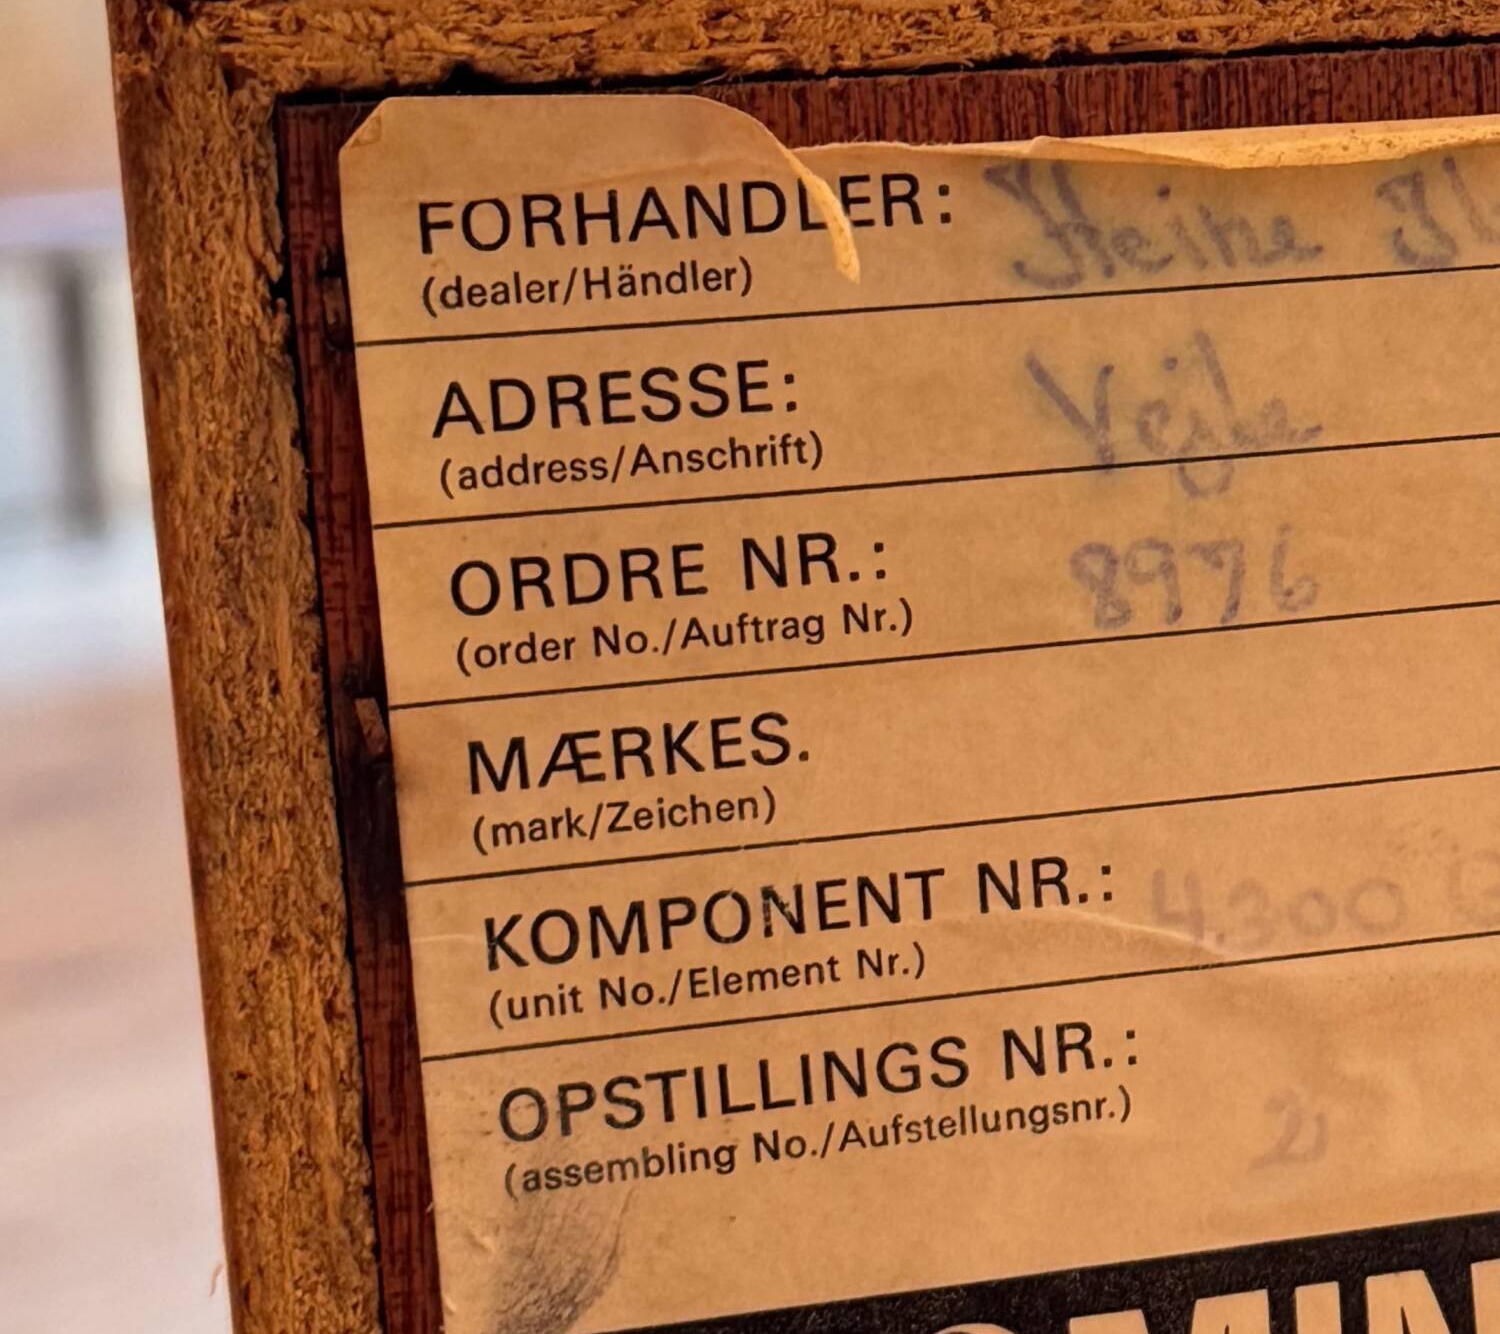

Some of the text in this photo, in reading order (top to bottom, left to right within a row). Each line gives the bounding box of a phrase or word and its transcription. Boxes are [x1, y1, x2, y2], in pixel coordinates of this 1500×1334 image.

[422, 257, 751, 318] (dealer/Händler)
[432, 360, 796, 438] ADRESSE:
[441, 431, 822, 499] (address/Anschrift)
[451, 533, 885, 616] ORDRE NR.:
[1070, 524, 1320, 630] 8976
[457, 598, 912, 677] (order No./Auftrag Nr.)
[468, 712, 808, 795] MÆRKES.
[474, 786, 775, 855] (mark/Zeichen)
[485, 857, 1112, 971] KOMPONENT NR.:
[490, 942, 924, 1029] (unit No./Element Nr.)
[499, 1022, 1136, 1142] OPSTILLINGS NR.:
[505, 1085, 1130, 1201] (assembling No./Aufstellungsnr.)
